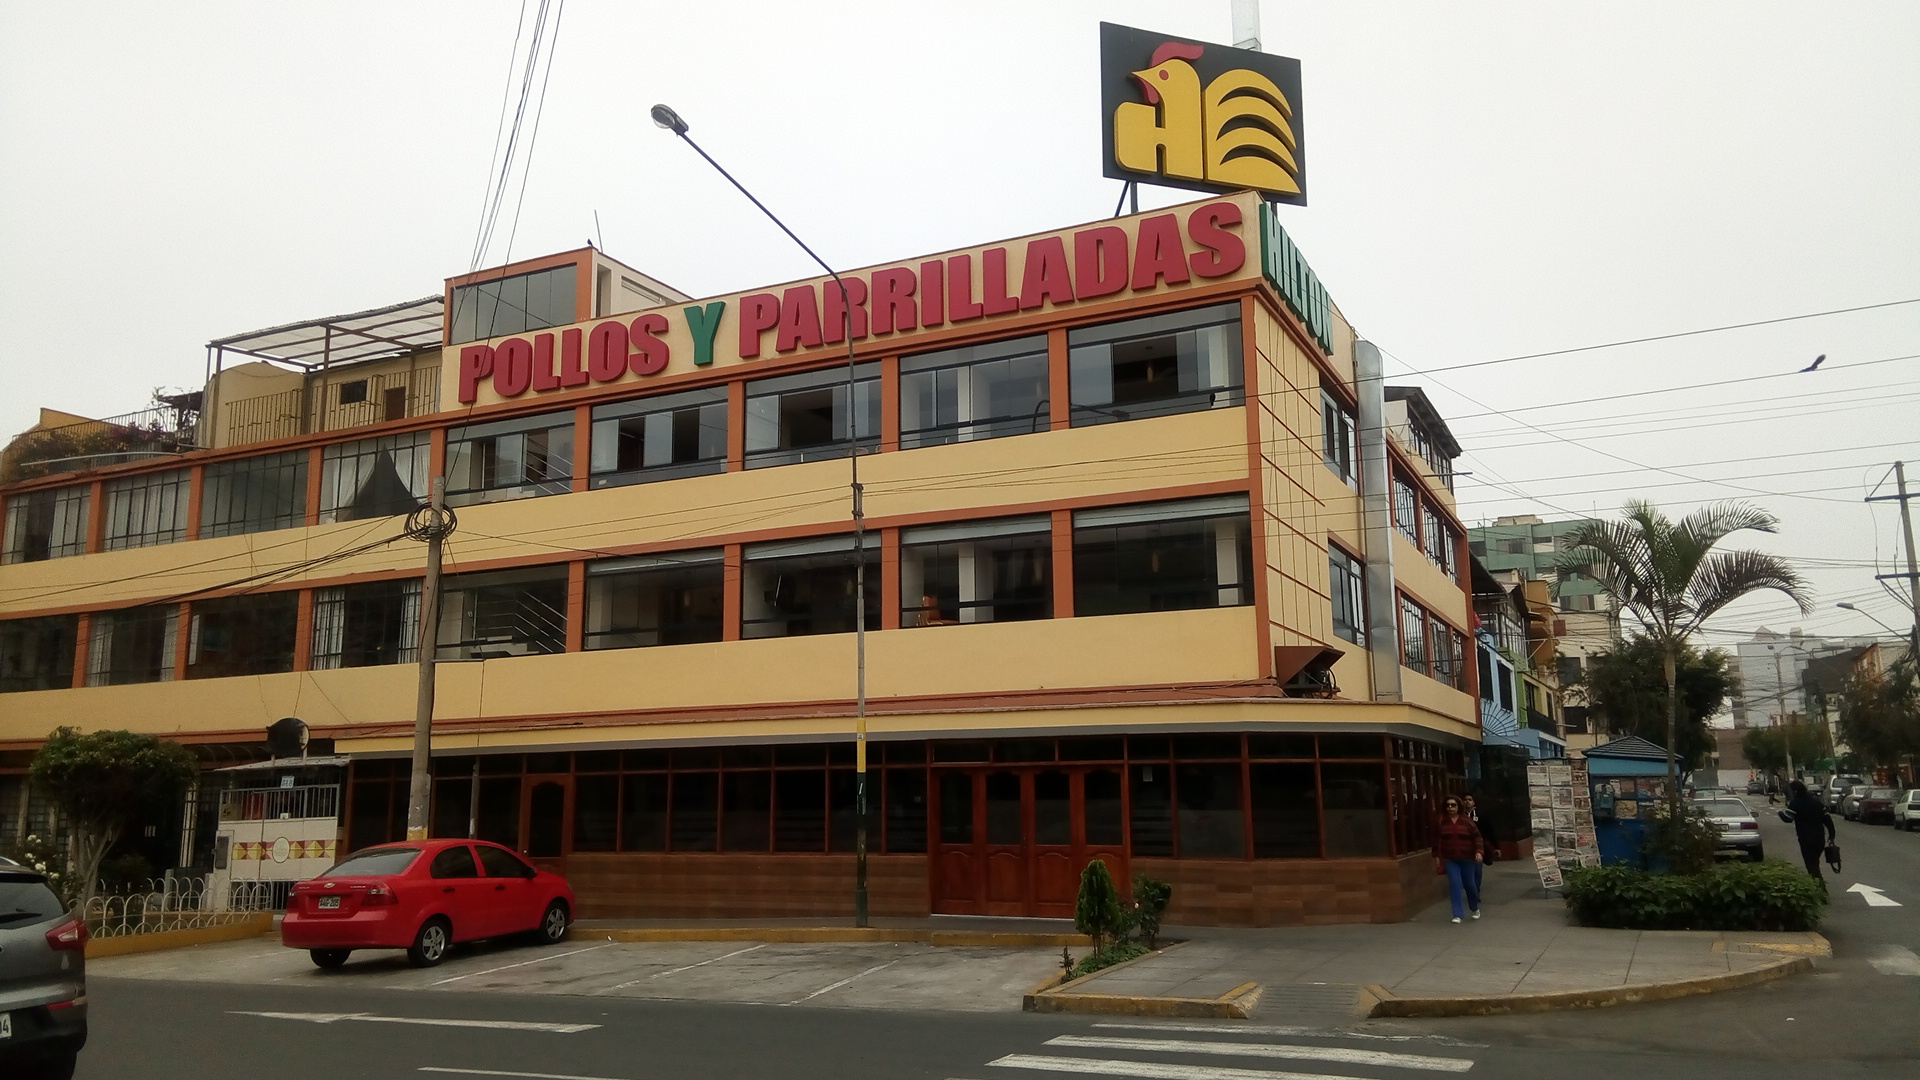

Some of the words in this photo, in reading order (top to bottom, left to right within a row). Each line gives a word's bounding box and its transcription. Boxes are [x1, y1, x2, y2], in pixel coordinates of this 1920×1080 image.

[458, 313, 670, 403] POLLOS
[684, 301, 726, 365] Y
[739, 202, 1246, 358] PARRILLADAS
[1259, 203, 1334, 356] HILTON
